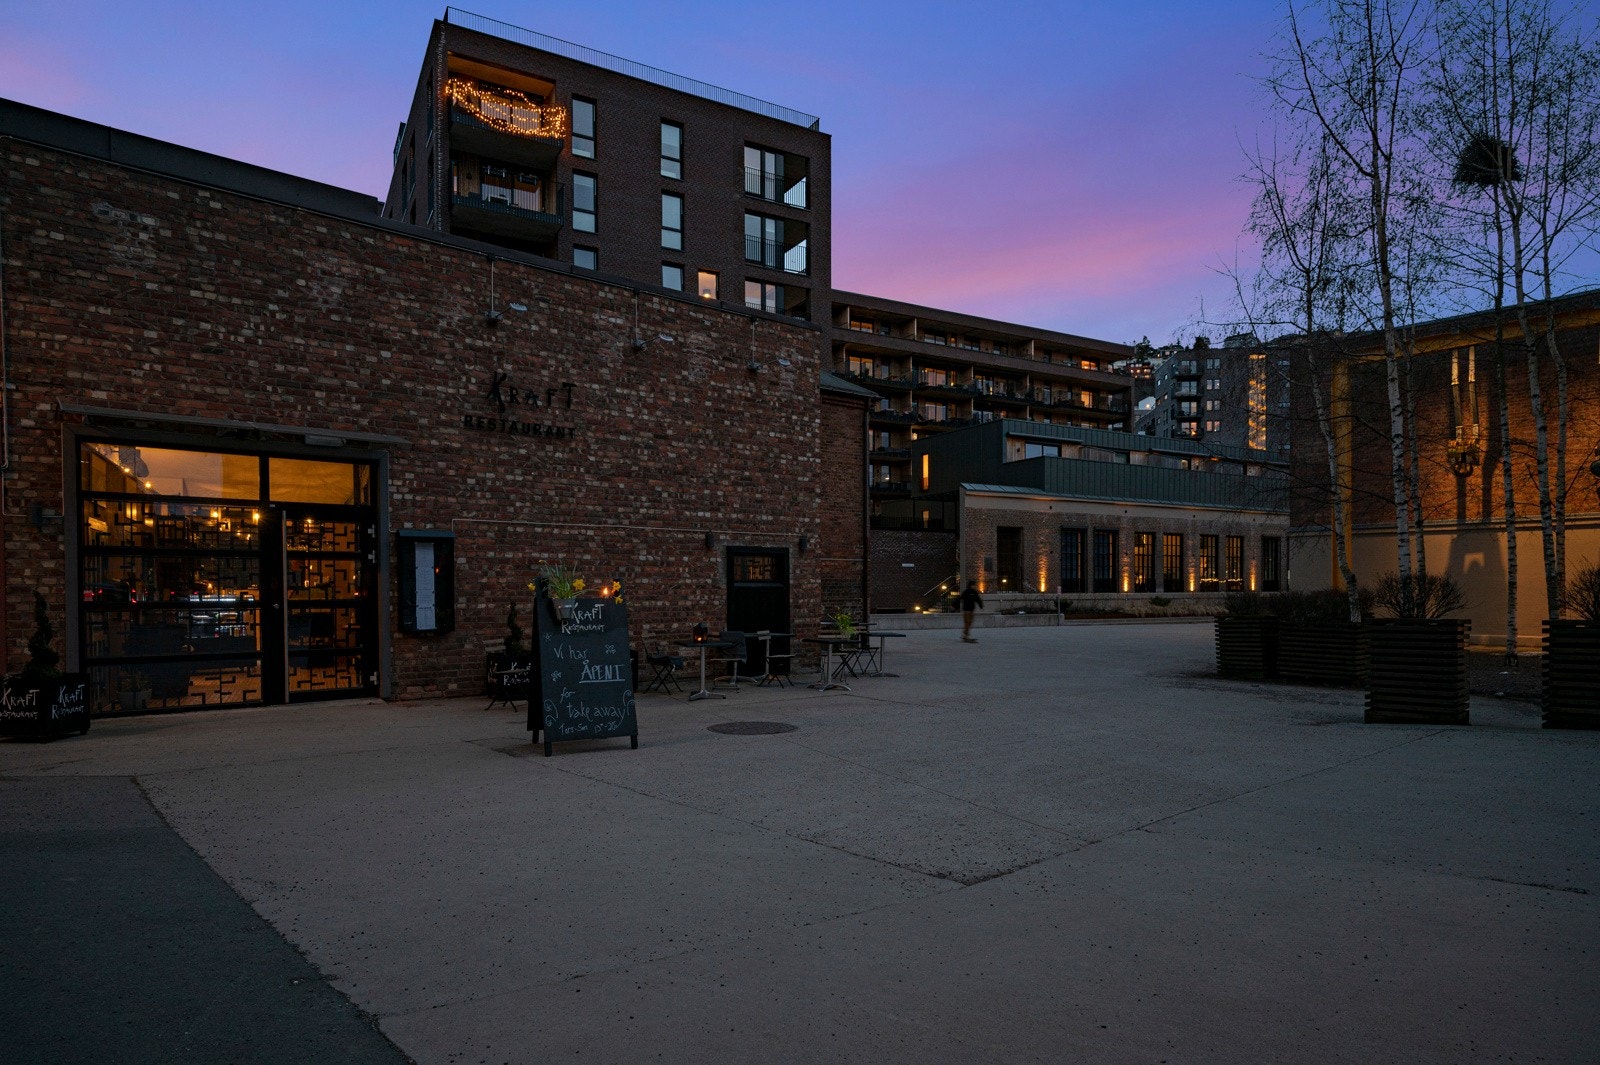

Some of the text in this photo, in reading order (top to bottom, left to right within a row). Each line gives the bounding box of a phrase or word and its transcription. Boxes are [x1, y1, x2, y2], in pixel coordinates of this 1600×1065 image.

[487, 371, 577, 413] KRAFT
[464, 415, 576, 438] RESTAURANT
[570, 602, 605, 624] KRAFT
[553, 642, 588, 660] Vi har
[580, 660, 625, 680] ÅPENT
[0, 687, 41, 710] KRAFT
[58, 684, 86, 707] KRAFT
[560, 686, 576, 704] for
[566, 701, 626, 727] take away
